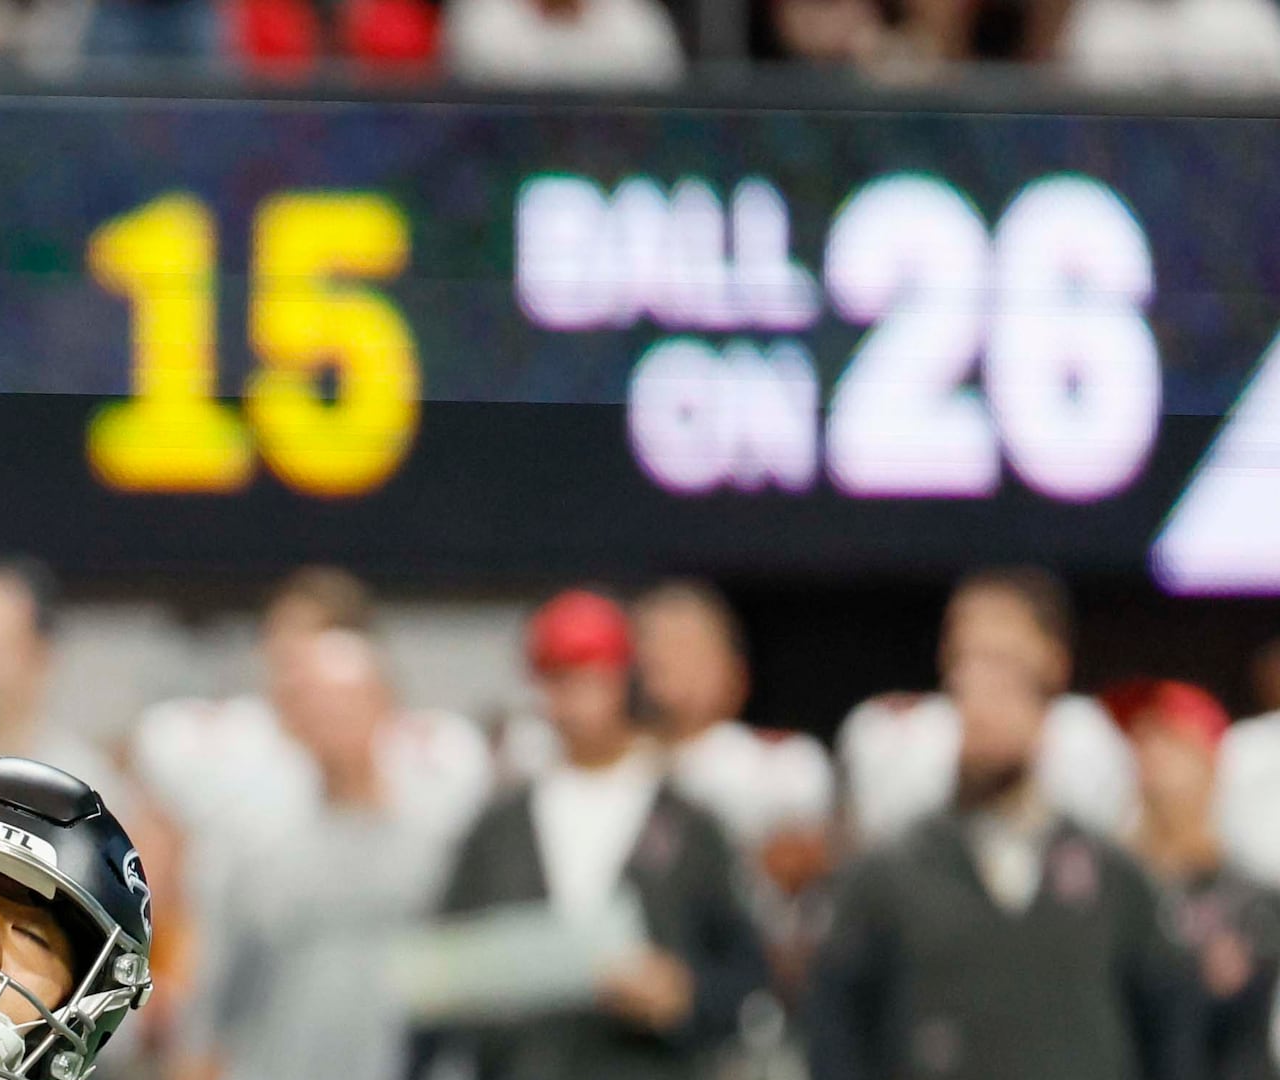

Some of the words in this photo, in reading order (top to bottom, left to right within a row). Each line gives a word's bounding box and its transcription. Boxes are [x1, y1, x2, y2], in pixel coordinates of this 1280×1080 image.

[85, 190, 422, 496] 15
[515, 172, 822, 331] BALL
[825, 172, 1163, 502] 26
[627, 336, 820, 494] ON
